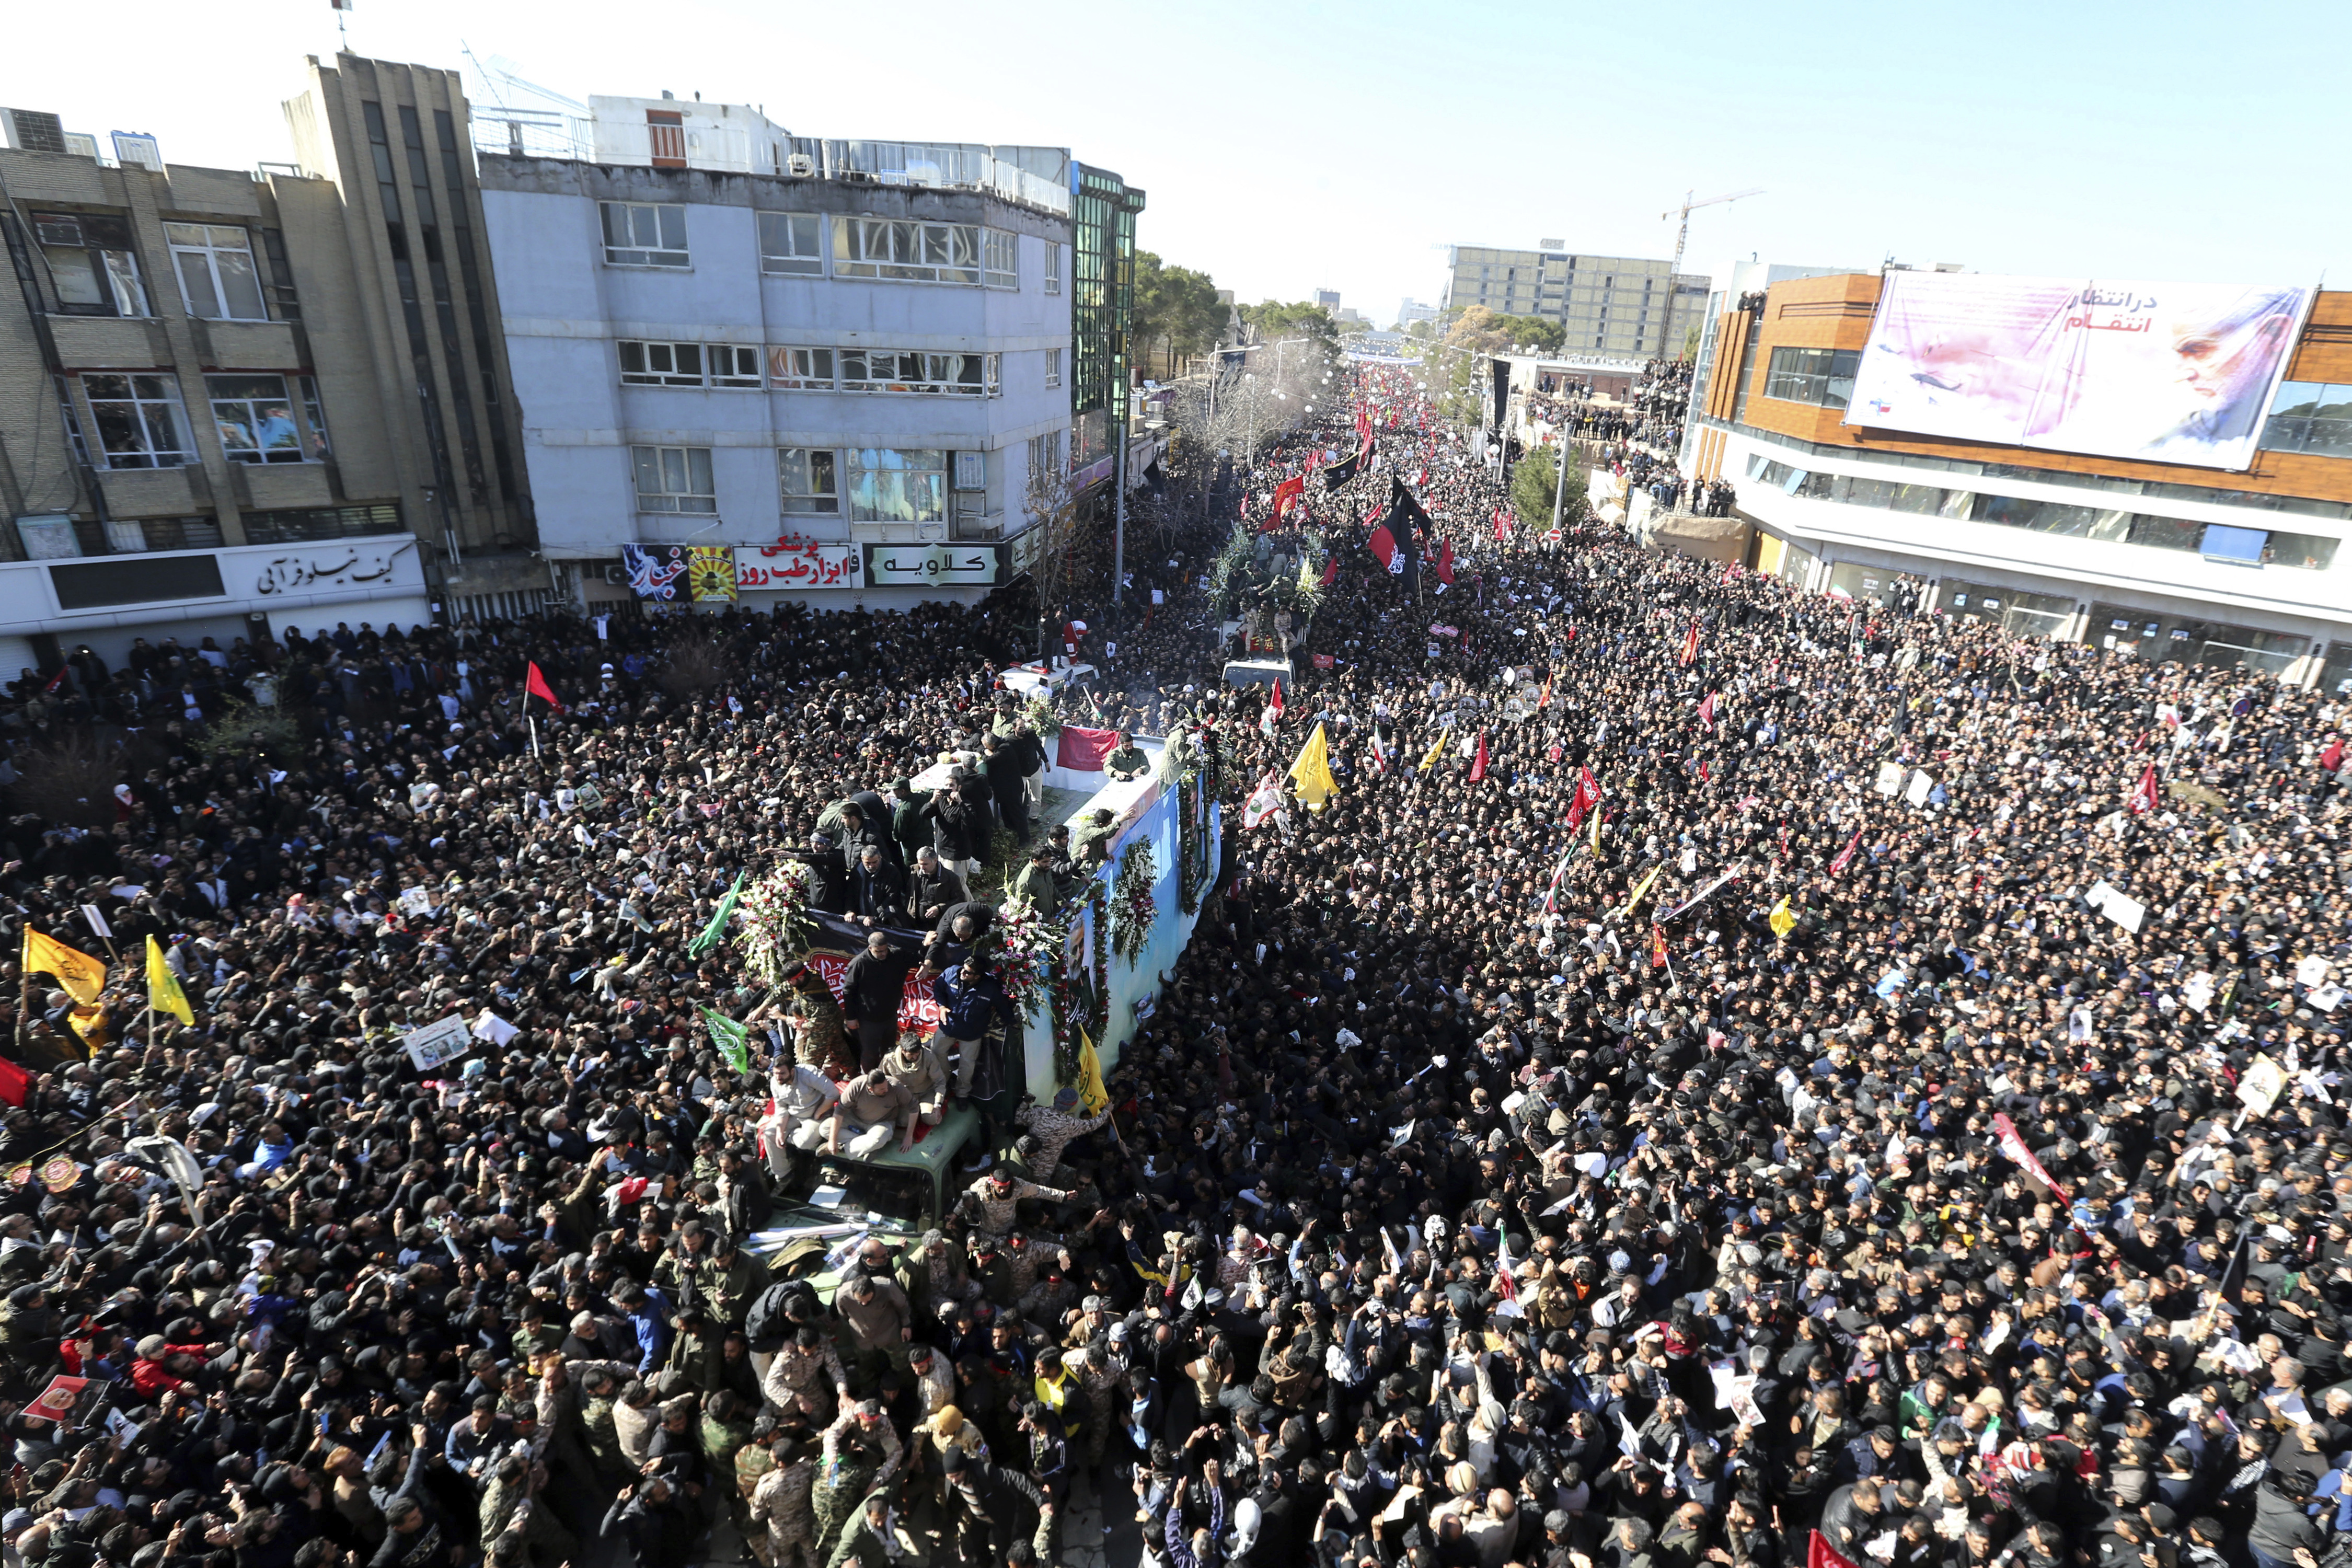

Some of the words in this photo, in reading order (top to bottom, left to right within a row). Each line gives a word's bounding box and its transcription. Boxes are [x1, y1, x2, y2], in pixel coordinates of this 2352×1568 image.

[2067, 289, 2133, 309] انتظار
[2129, 296, 2158, 313] در
[2063, 313, 2152, 332] انتقام
[760, 532, 819, 561] پزشکی
[258, 558, 287, 594] آبی
[291, 548, 358, 586] نیلوفر
[351, 541, 414, 584] کیف
[629, 547, 687, 599] غبار
[737, 562, 769, 585] روز
[771, 557, 810, 585] طب
[808, 557, 848, 584] ابزار
[883, 554, 986, 575] کلاویه
